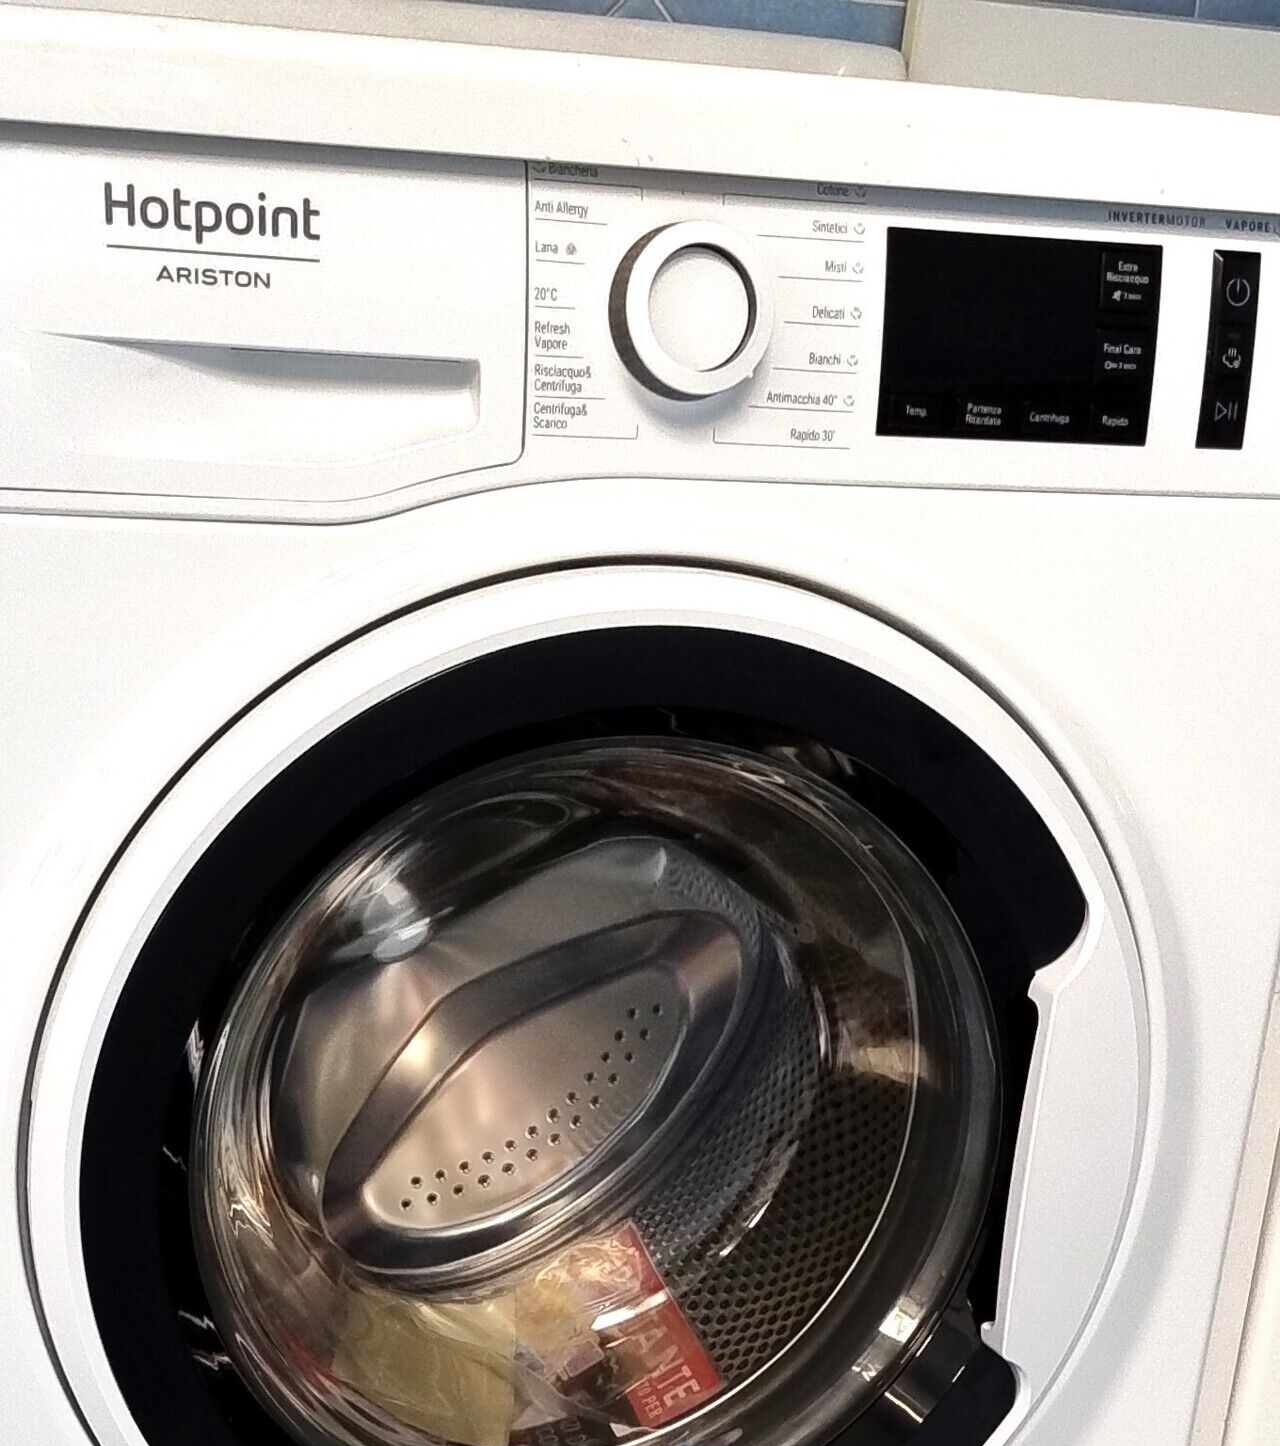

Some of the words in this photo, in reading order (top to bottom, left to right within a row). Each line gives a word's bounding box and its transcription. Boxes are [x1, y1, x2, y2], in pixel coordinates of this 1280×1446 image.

[104, 181, 321, 244] Hotpoint
[534, 200, 554, 212] Anti
[556, 201, 588, 219] Allergy
[812, 219, 848, 234] Sintetici
[1225, 218, 1270, 233] VAPORE
[535, 240, 558, 254] Lana
[825, 260, 847, 273] Misti
[156, 265, 271, 289] ARISTON
[534, 287, 558, 301] 20°C
[812, 305, 846, 320] Delicati
[534, 320, 571, 335] Refresh
[534, 336, 568, 351] Vapore
[808, 352, 842, 366] Bianchi
[534, 379, 582, 395] Centrifuga
[766, 390, 821, 405] Antimacchia
[533, 416, 568, 429] Scarico
[790, 428, 820, 443] Rapido
